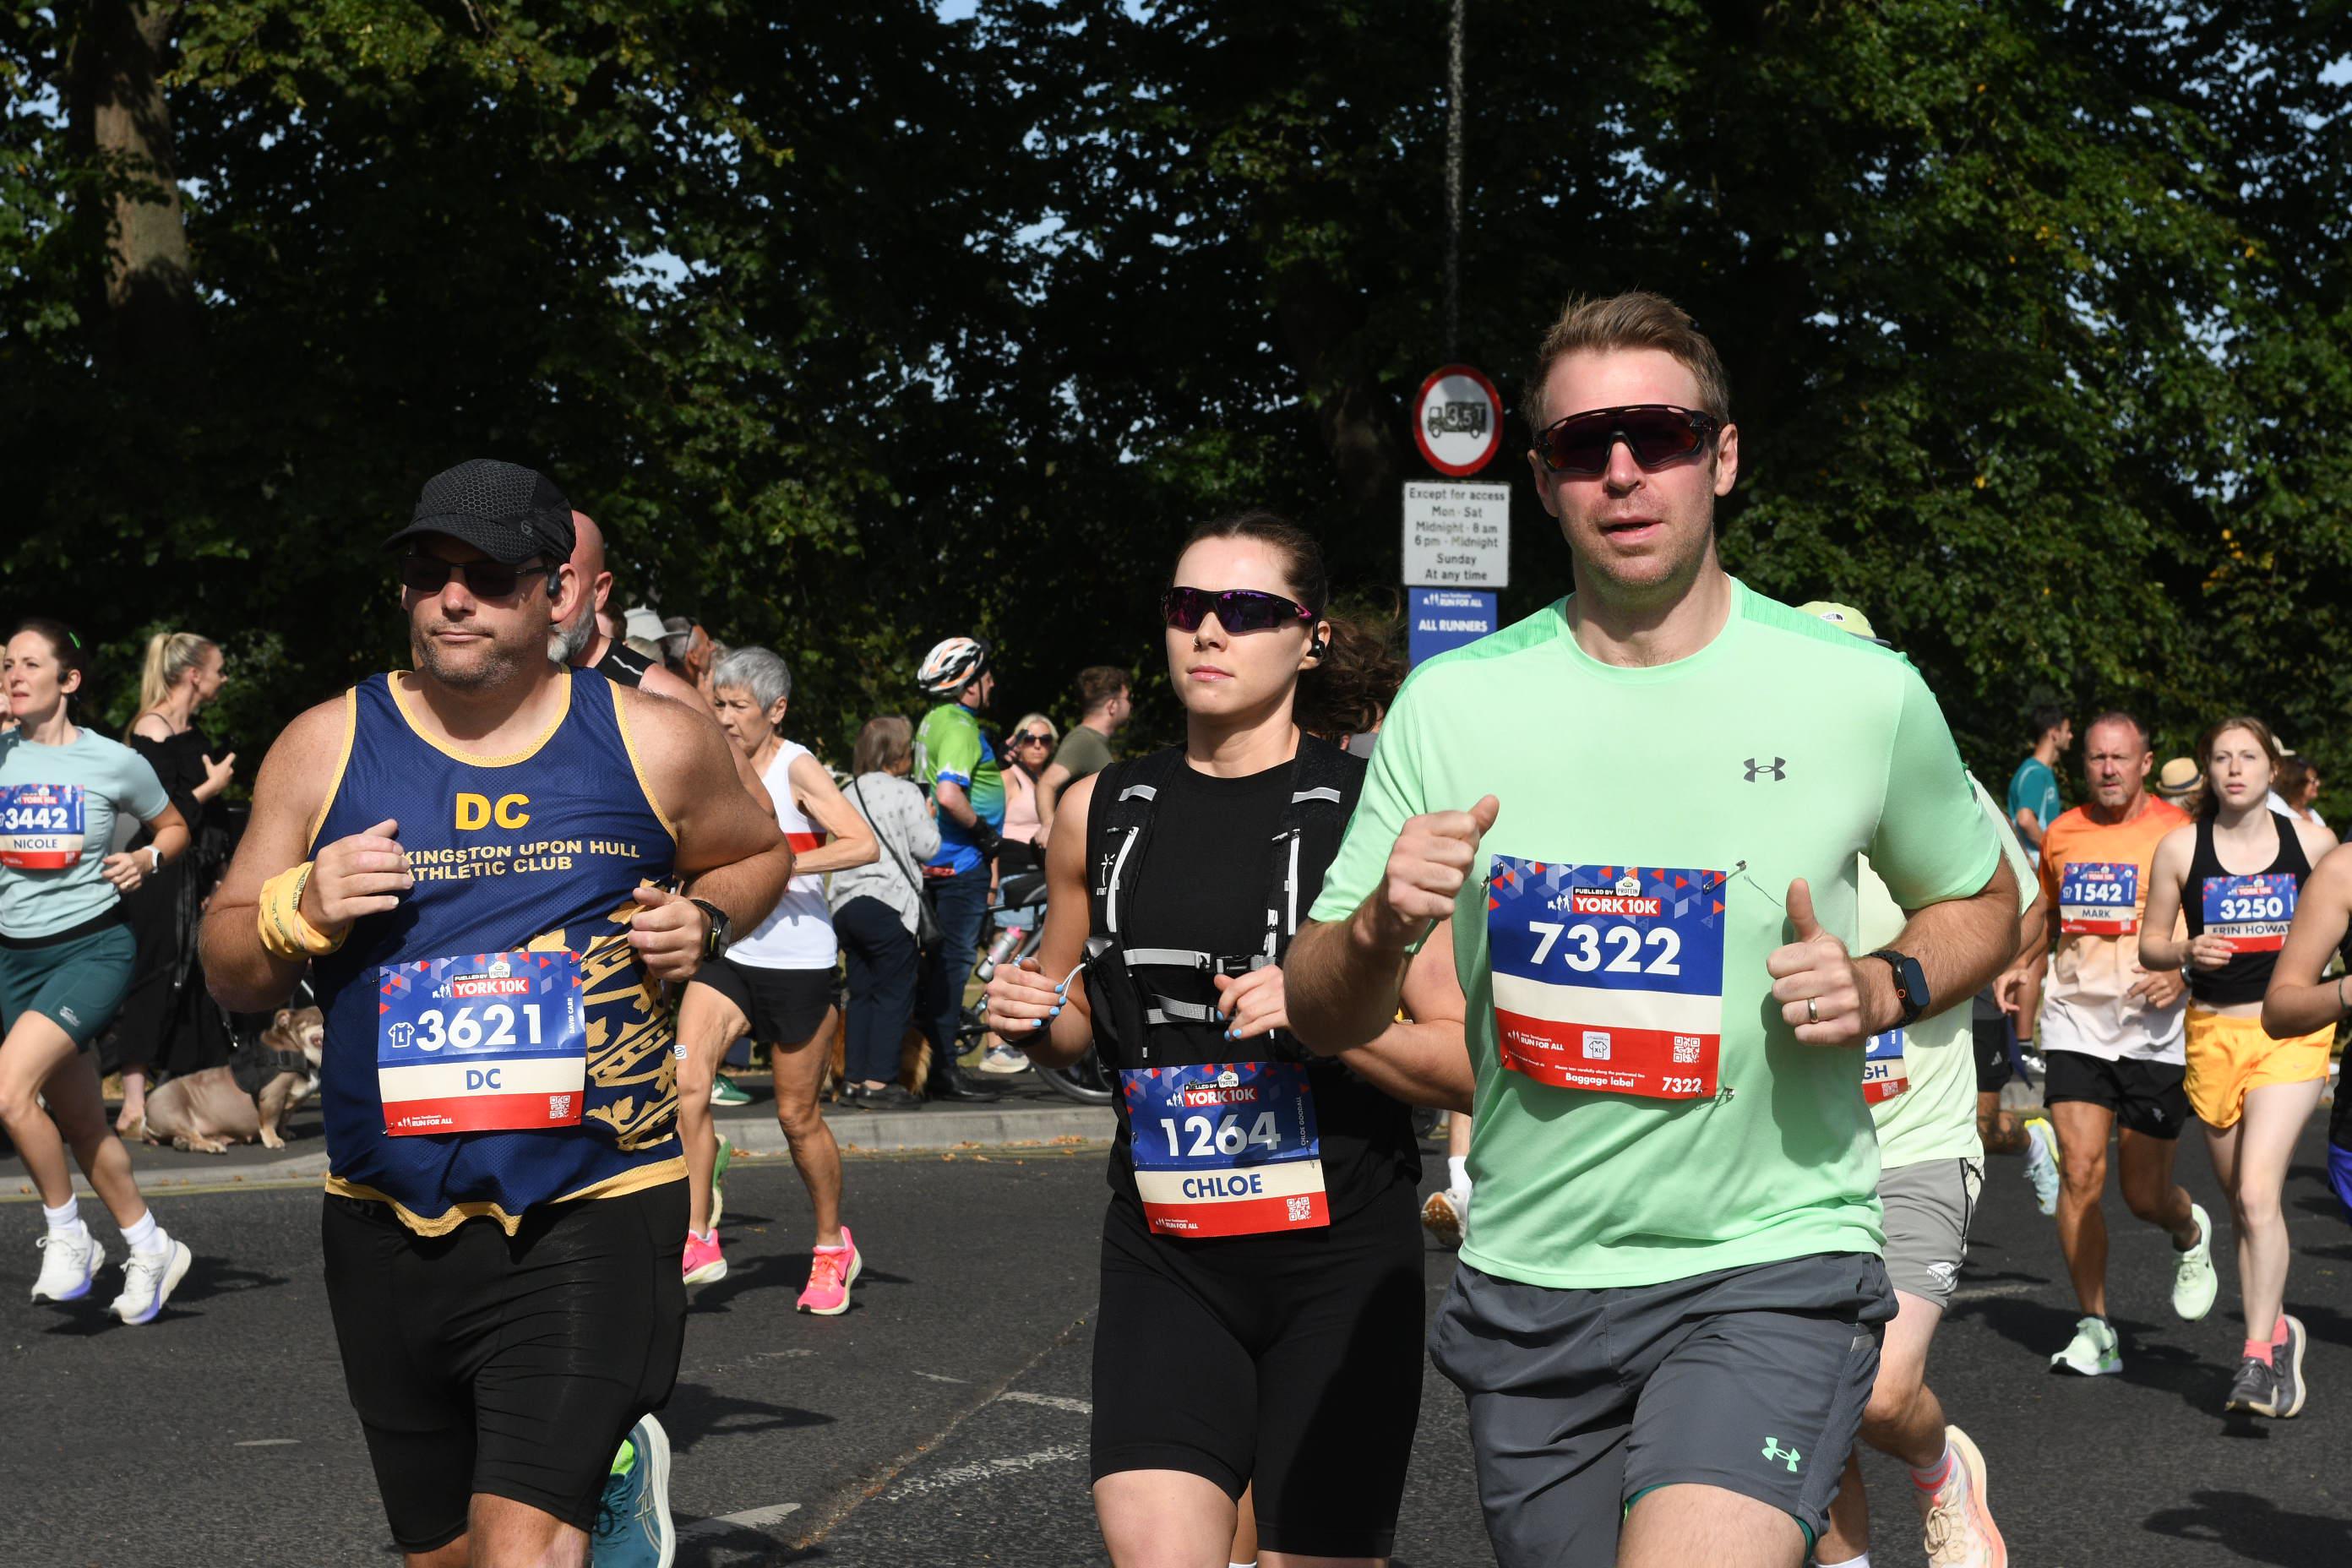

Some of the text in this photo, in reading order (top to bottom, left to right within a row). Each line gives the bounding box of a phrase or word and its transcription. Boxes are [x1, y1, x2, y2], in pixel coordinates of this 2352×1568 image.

[1409, 487, 1505, 501] Except for access
[1431, 506, 1455, 517] Mon
[1464, 507, 1483, 518] Sat
[1416, 520, 1463, 534] Midnight
[1473, 522, 1479, 533] 8
[1483, 525, 1498, 534] am
[1414, 535, 1422, 546] 6
[1424, 537, 1440, 547] pm
[1451, 536, 1499, 549] Midnight
[1436, 553, 1477, 566] Sunday
[1425, 569, 1488, 582] At any time
[1418, 619, 1489, 633] ALL RUNNERS
[4, 807, 68, 830] 3442
[455, 792, 531, 830] DC
[14, 839, 58, 849] NICOLE
[401, 841, 641, 865] KINGSTON UPON HULL
[513, 856, 574, 874] CLUB
[2074, 883, 2122, 901] 1542
[1575, 896, 1658, 915] YORK 10K
[2082, 909, 2110, 918] MARK
[2219, 896, 2284, 920] 3250
[1528, 921, 1681, 977] 7322
[455, 979, 526, 996] YORK 10K
[416, 1004, 542, 1052] 3621
[399, 1032, 405, 1043] L
[1521, 1037, 1534, 1046] RUN
[466, 1068, 502, 1090] DC
[1565, 1072, 1634, 1087] Baggage label
[1662, 1076, 1702, 1093] 7322
[1187, 1088, 1256, 1105] YORK 10K
[1296, 1096, 1304, 1125] GOODALL
[1160, 1111, 1282, 1157] 1264
[1182, 1173, 1263, 1199] CHLOE
